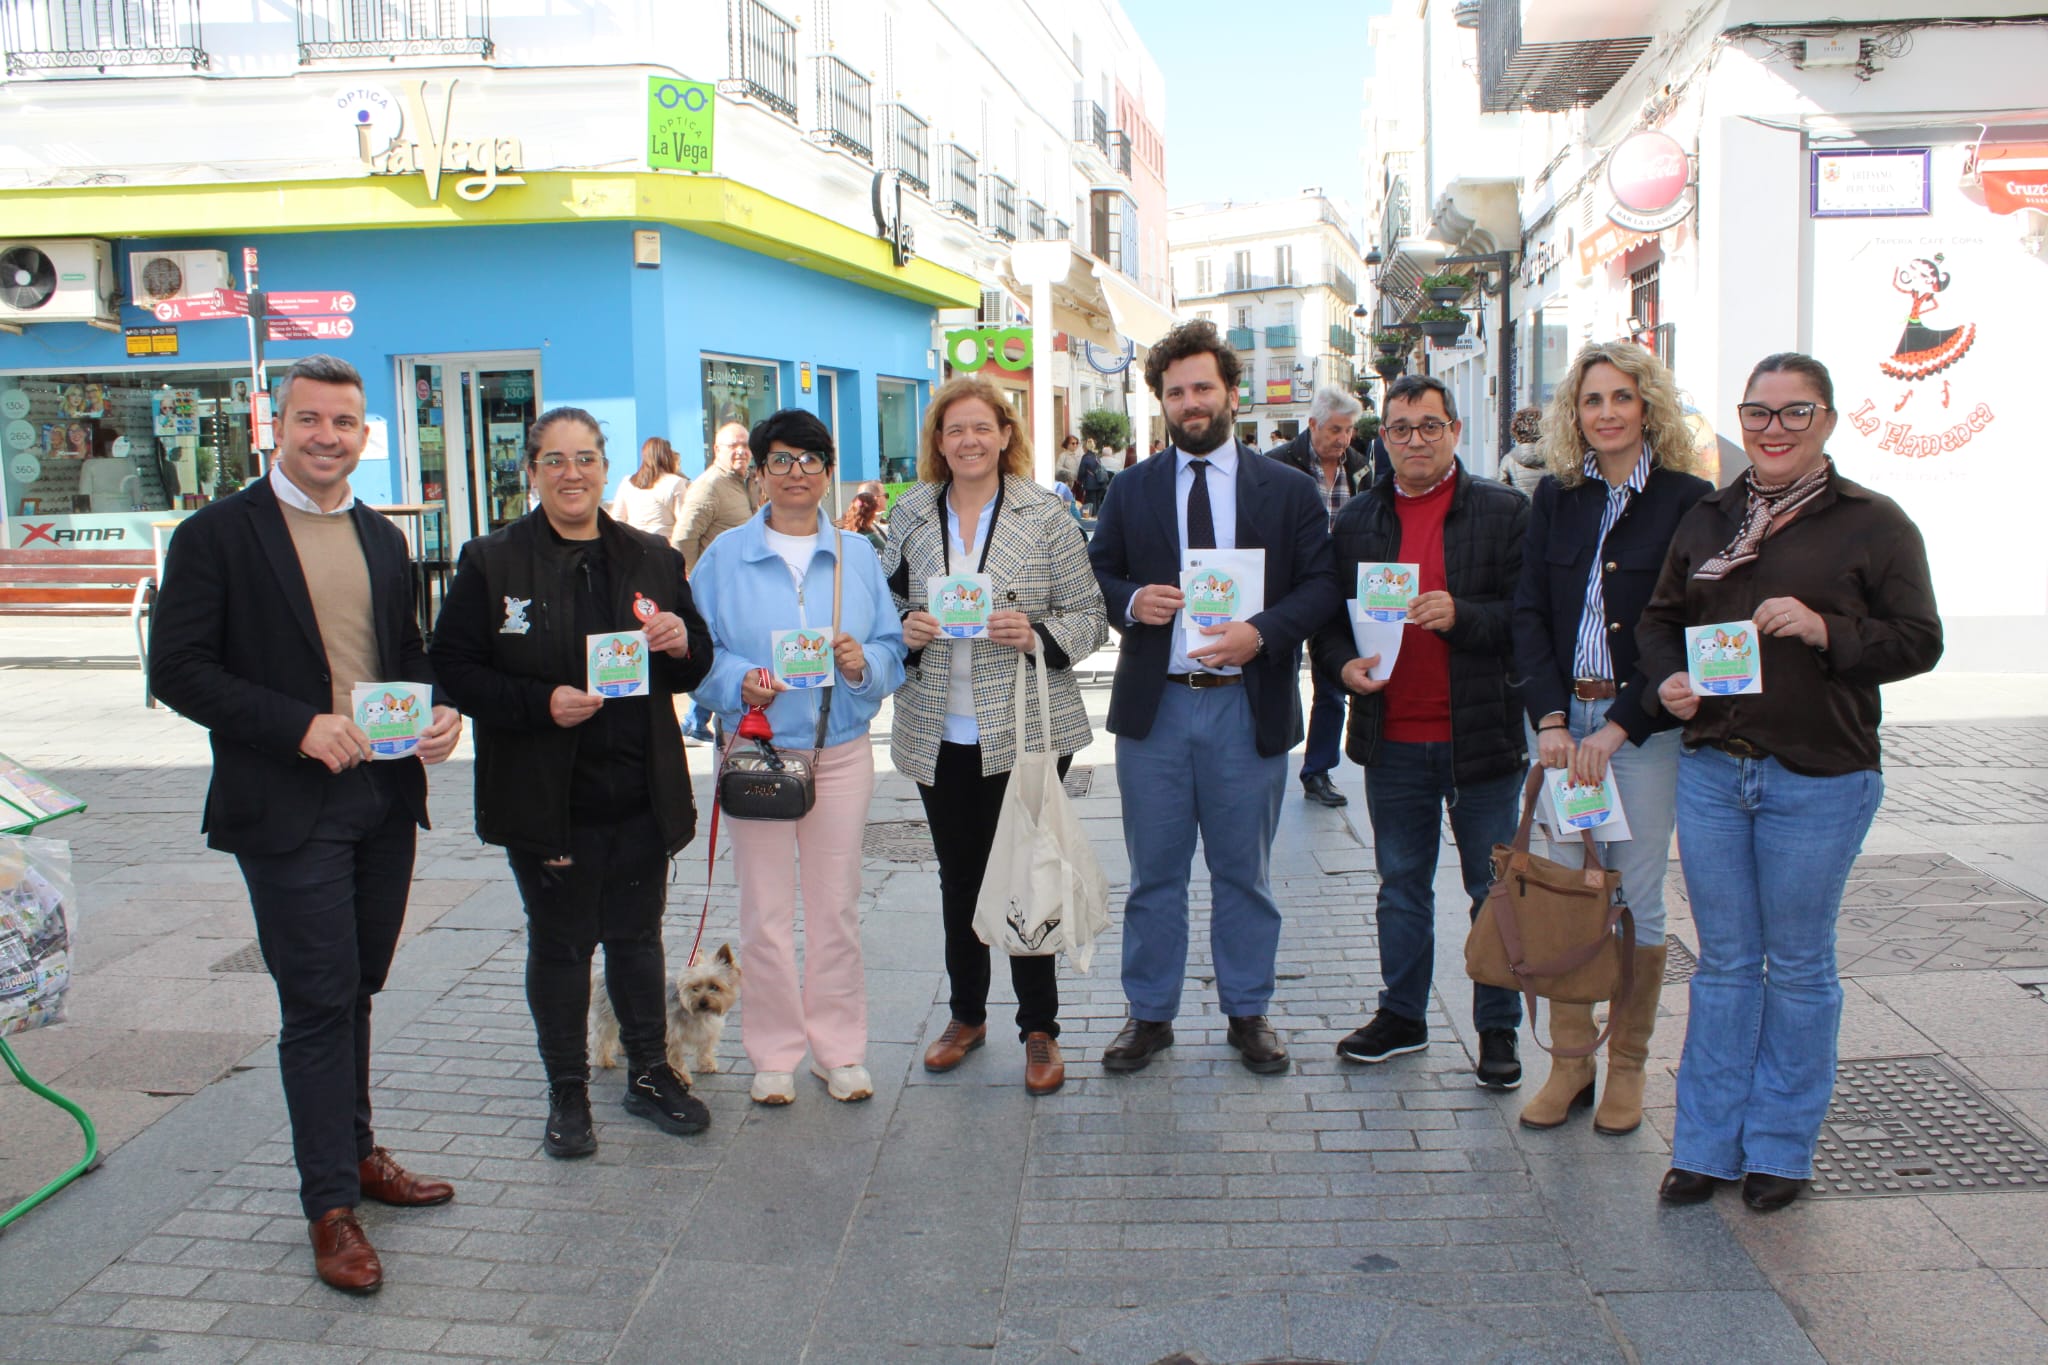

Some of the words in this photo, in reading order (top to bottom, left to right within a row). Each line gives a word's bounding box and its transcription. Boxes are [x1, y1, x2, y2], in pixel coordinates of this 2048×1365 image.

[355, 123, 416, 174] La
[400, 79, 527, 201] Vega
[652, 134, 668, 155] La
[673, 132, 708, 164] Vega
[1616, 211, 1632, 223] BAR
[1634, 218, 1644, 226] LA
[1646, 205, 1688, 226] FLAMENCA
[1848, 398, 1880, 437] La
[1878, 402, 1995, 458] Flamenca
[19, 523, 125, 548] XAMA
